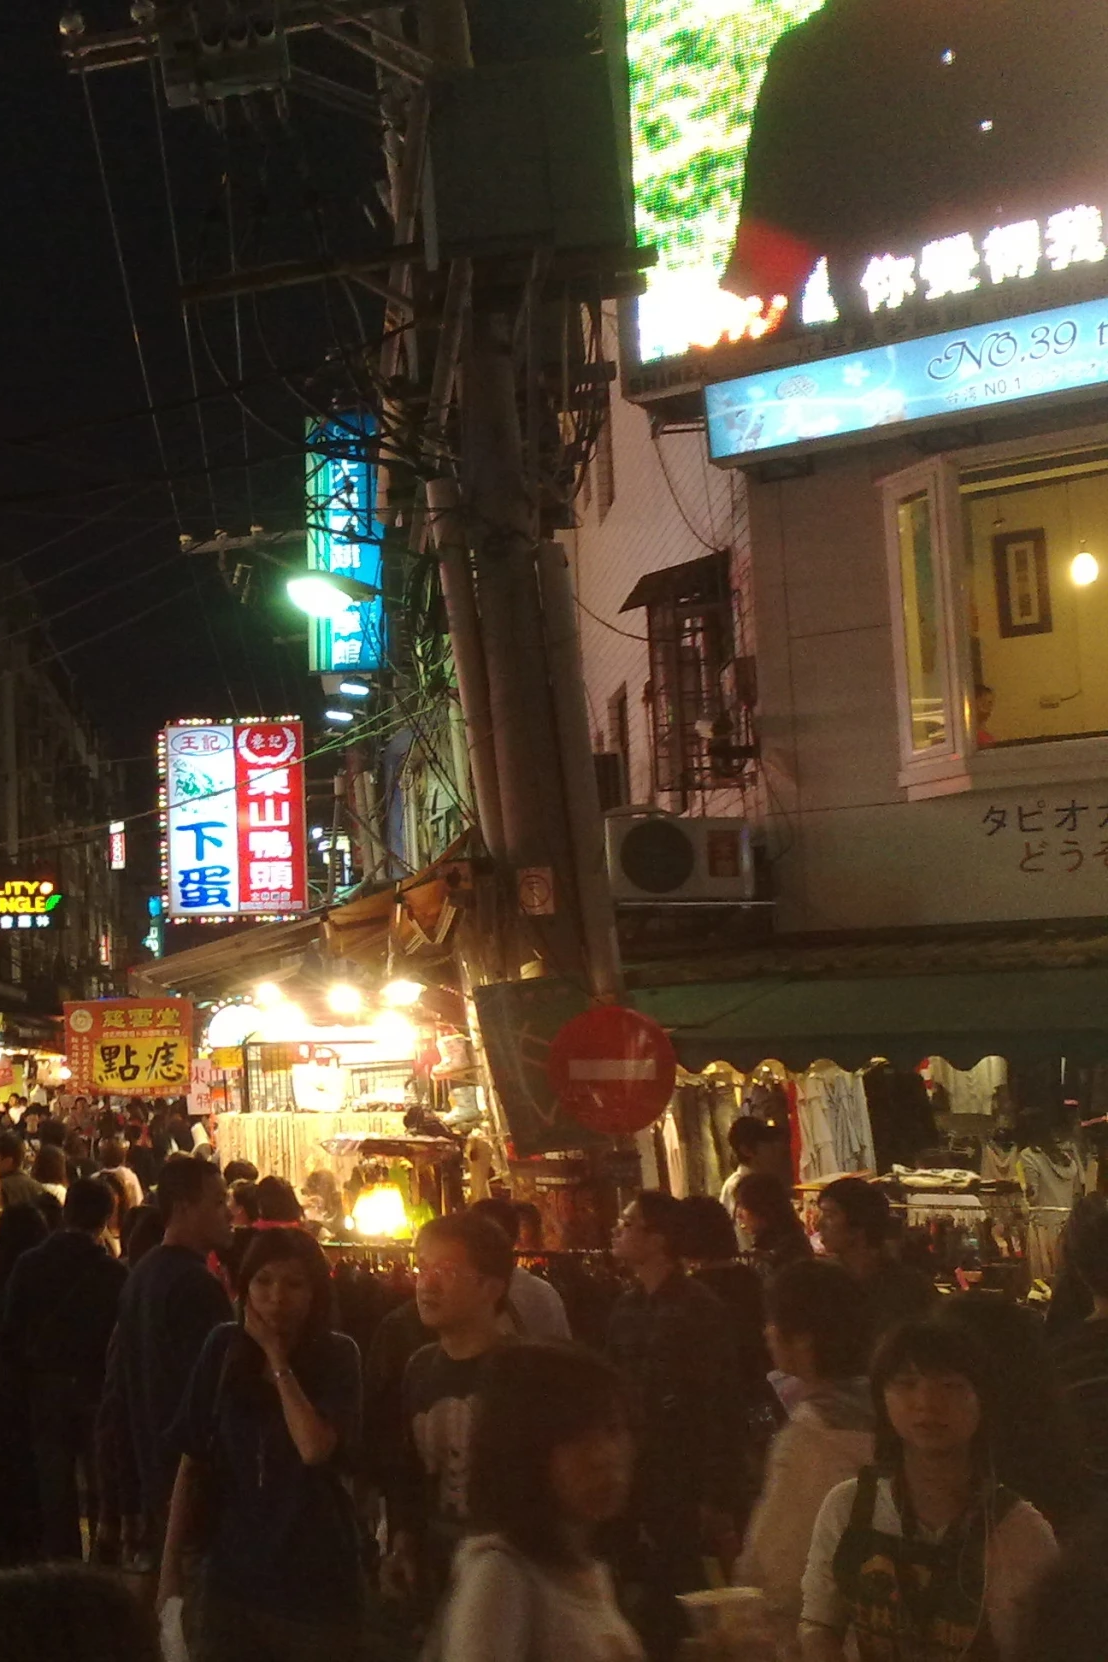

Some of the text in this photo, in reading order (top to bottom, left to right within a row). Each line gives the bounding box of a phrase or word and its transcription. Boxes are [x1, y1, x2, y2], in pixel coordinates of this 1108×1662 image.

[927, 320, 1078, 380] NO.39
[180, 734, 220, 751] 王記
[175, 821, 231, 908] 下蛋
[98, 1041, 185, 1083] 點痣
